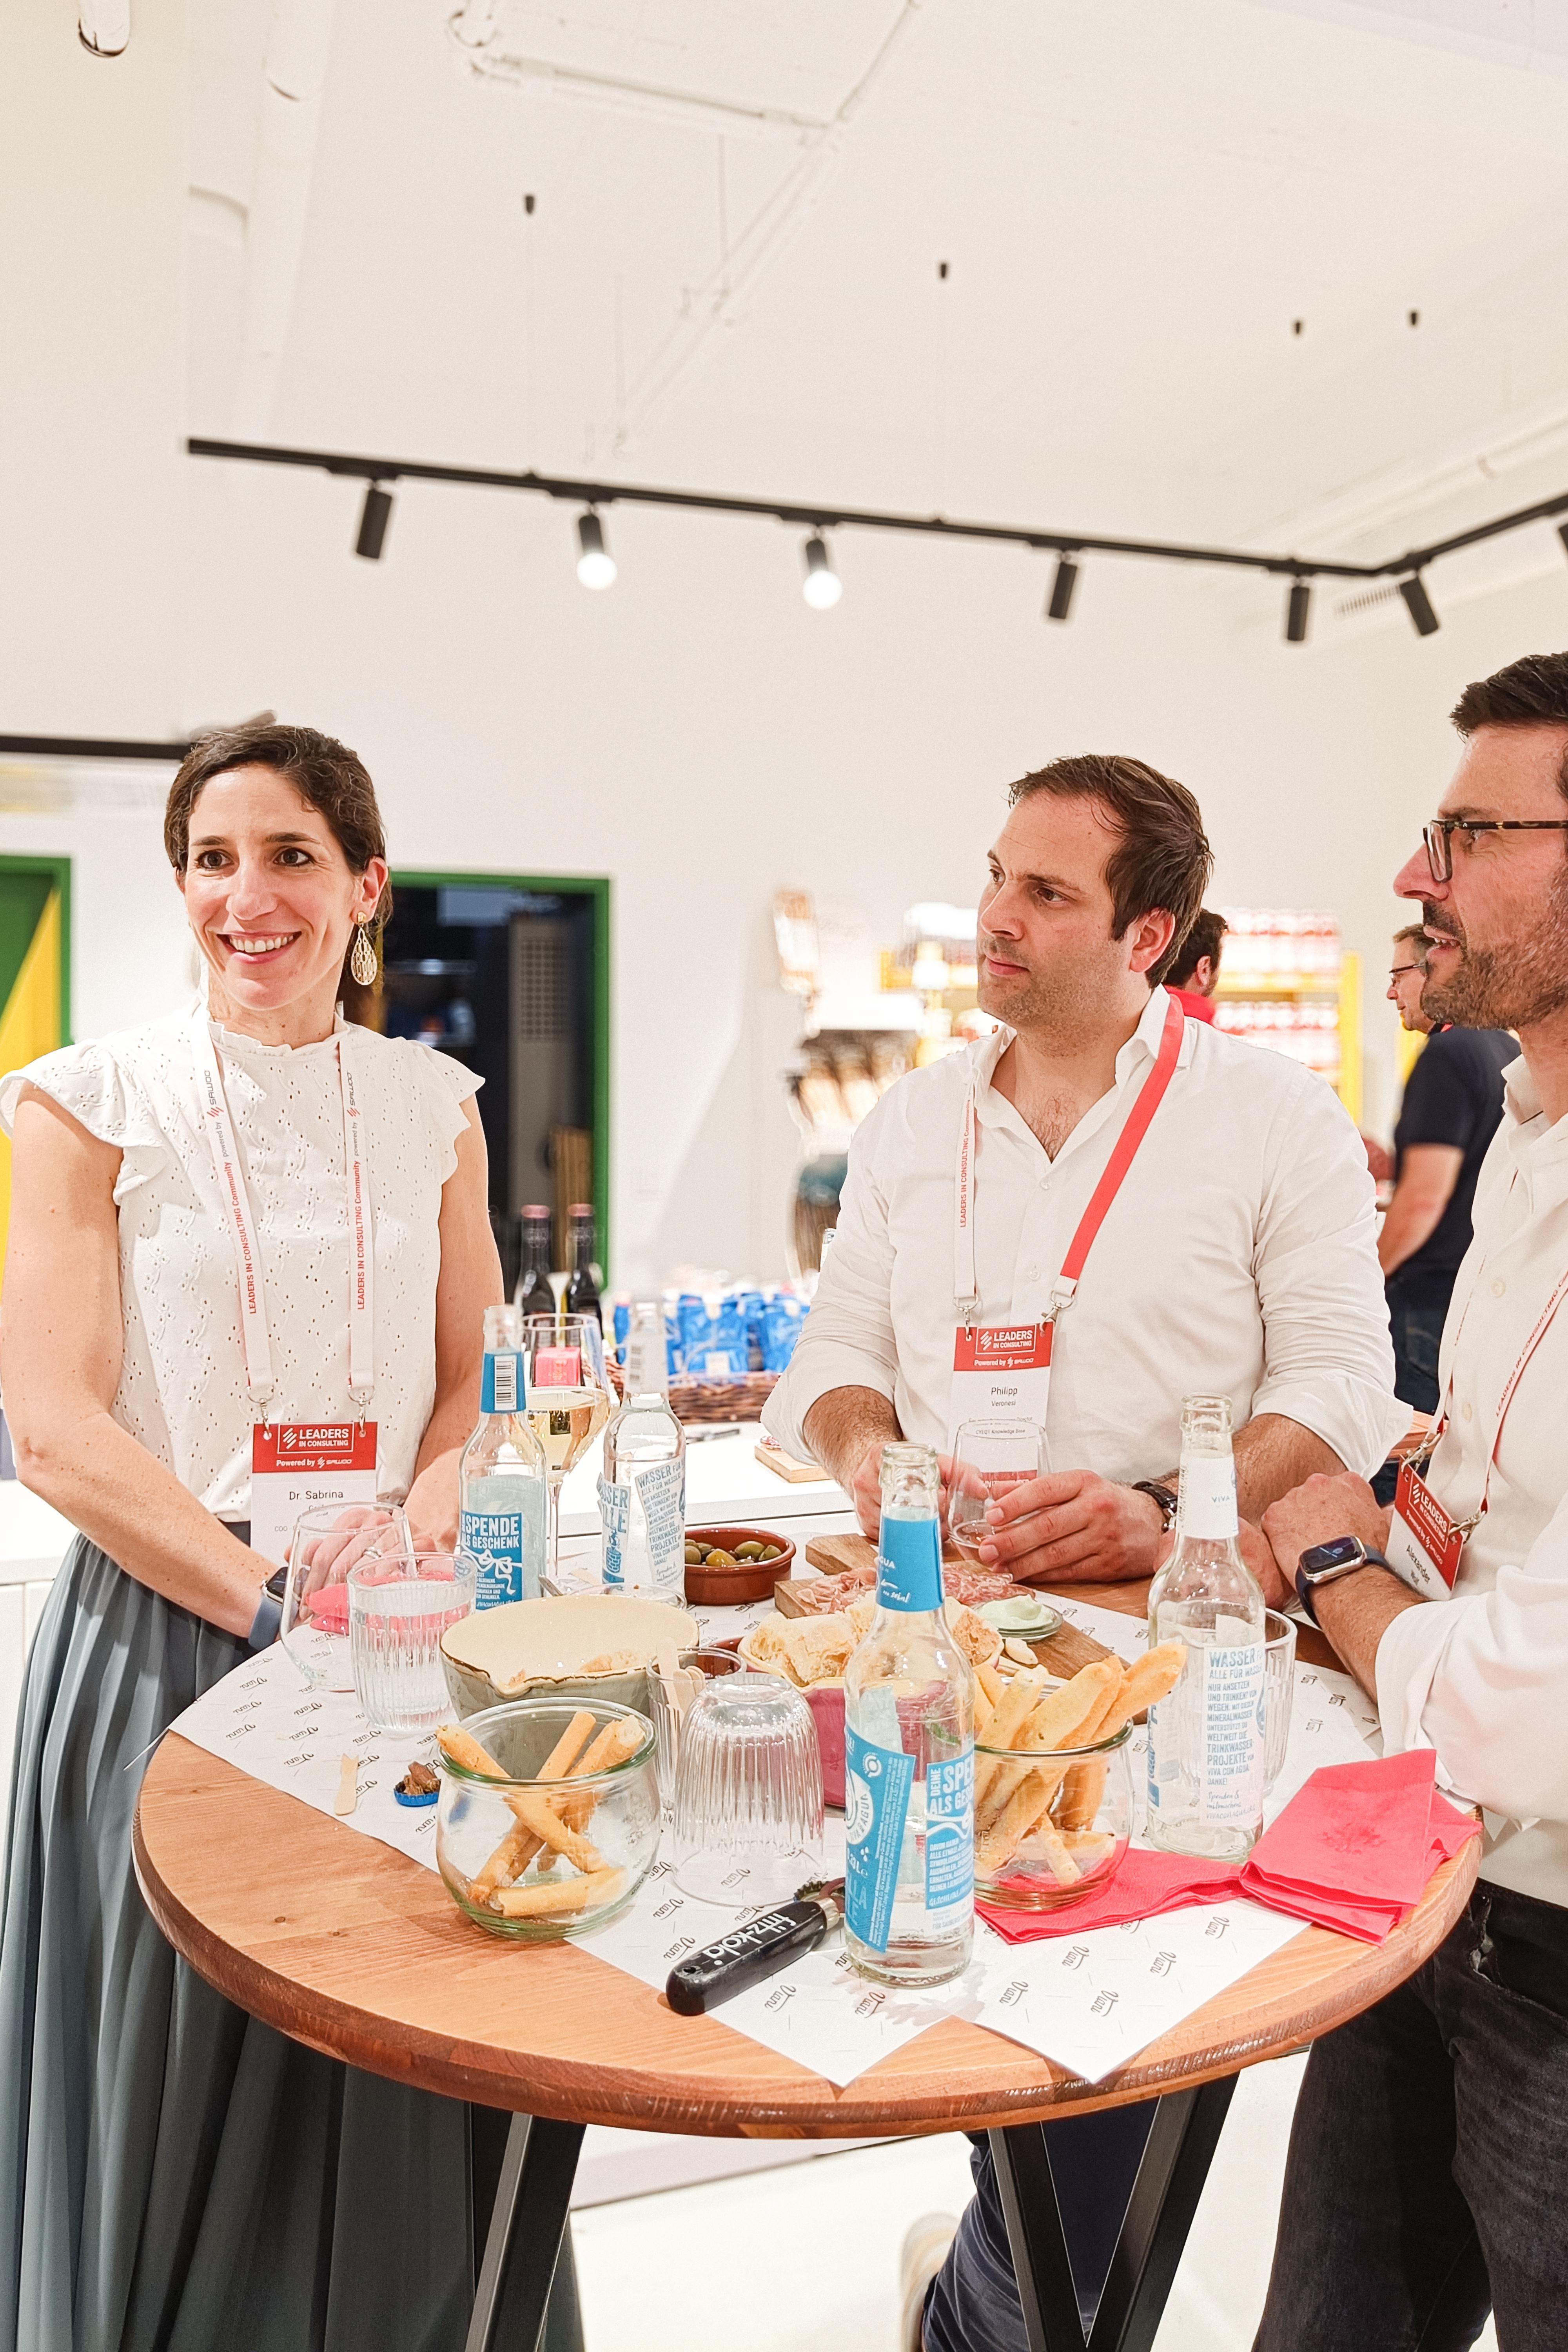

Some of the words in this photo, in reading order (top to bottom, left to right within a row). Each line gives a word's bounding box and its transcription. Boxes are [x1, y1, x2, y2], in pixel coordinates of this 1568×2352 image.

[216, 1131, 229, 1157] powered
[224, 1161, 239, 1206] Community
[353, 1160, 361, 1204] Community
[234, 1208, 252, 1261] CONSULTING
[355, 1206, 364, 1258] CONSULTING
[246, 1263, 252, 1272] IN
[358, 1260, 365, 1269] IN
[247, 1274, 256, 1314] LEADERS
[994, 1330, 1033, 1341] LEADERS
[1496, 1370, 1515, 1417] LEADERS
[1516, 1356, 1522, 1368] IN
[1522, 1289, 1558, 1356] CONSULTING
[991, 1387, 1018, 1396] Philipp
[299, 1428, 349, 1440] LEADERS
[276, 1459, 306, 1467] Powered
[306, 1458, 316, 1467] by
[637, 1465, 671, 1488] WASSER
[289, 1491, 302, 1500] Dr.
[305, 1490, 343, 1499] Sabrina
[652, 1482, 663, 1493] FÜR
[1421, 1492, 1447, 1533] LEADERS
[465, 1514, 519, 1537] SPENDE
[1406, 1509, 1422, 1534] Powered
[1421, 1531, 1426, 1541] by
[1423, 1508, 1445, 1543] CONSULTING
[472, 1535, 520, 1549] GESCHENK
[650, 1534, 678, 1552] PROJEKTE
[1406, 1544, 1430, 1584] Alexander
[1209, 1648, 1255, 1668] WASSER
[1209, 1669, 1227, 1679] ALLE
[1229, 1667, 1243, 1679] FÜR
[240, 1677, 268, 1691] Viani
[1208, 1683, 1221, 1691] NUR
[1222, 1680, 1250, 1691] ANSETZEN
[1208, 1693, 1221, 1702] UND
[233, 1701, 262, 1715] Viani
[294, 1702, 323, 1717] Viani
[1207, 1709, 1252, 1722] MINERALWASSER
[226, 1724, 256, 1740] Viani
[289, 1726, 319, 1742] Viani
[353, 1730, 381, 1746] Viani
[1207, 1732, 1237, 1742] WELTWEIT
[1238, 1730, 1248, 1740] DIE
[283, 1753, 314, 1769] Viani
[1207, 1752, 1247, 1766] PROJEKTE
[1207, 1767, 1221, 1776] VIVA
[1222, 1766, 1234, 1775] CON
[1235, 1764, 1250, 1774] AGUA
[930, 1768, 941, 1797] DEINE
[929, 1795, 953, 1815] ALS
[1207, 1791, 1233, 1802] Spenden
[720, 1868, 751, 1889] Viani
[653, 1898, 684, 1920] Viani
[702, 1912, 797, 1960] fritz-kola
[1204, 1916, 1230, 1939] Viani
[663, 1937, 696, 1962] Viani
[1062, 1945, 1090, 1970] Viani
[1149, 1951, 1177, 1977] Viani
[764, 1985, 797, 2013] Viani
[999, 1981, 1029, 2007] Viani
[1090, 1990, 1119, 2017] Viani
[855, 1991, 886, 2018] Viani
